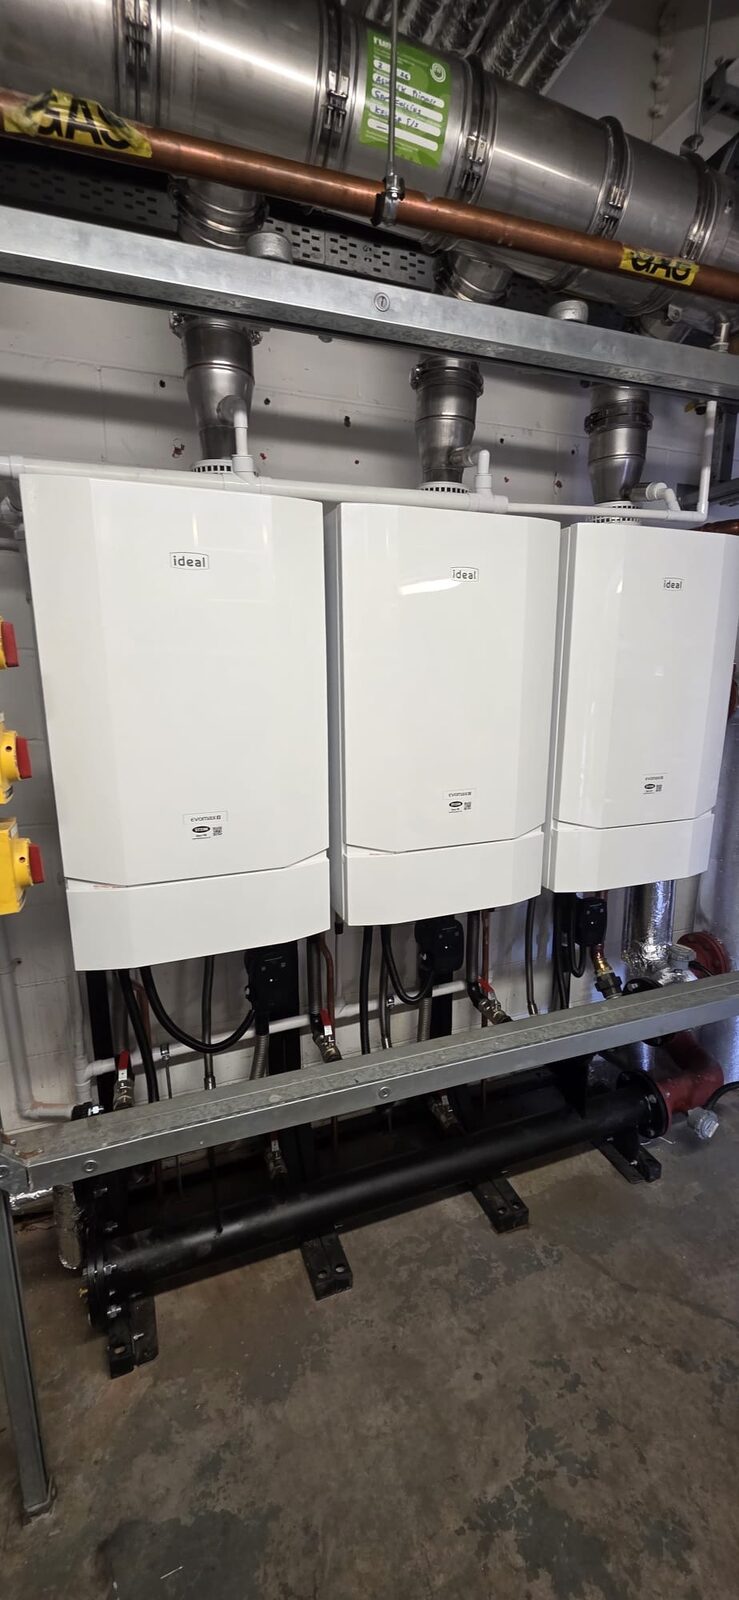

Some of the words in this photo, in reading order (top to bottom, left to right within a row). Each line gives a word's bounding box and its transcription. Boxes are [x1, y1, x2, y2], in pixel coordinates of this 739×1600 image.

[173, 555, 206, 568] ideal
[452, 569, 477, 580] ideal
[663, 579, 683, 589] ideal
